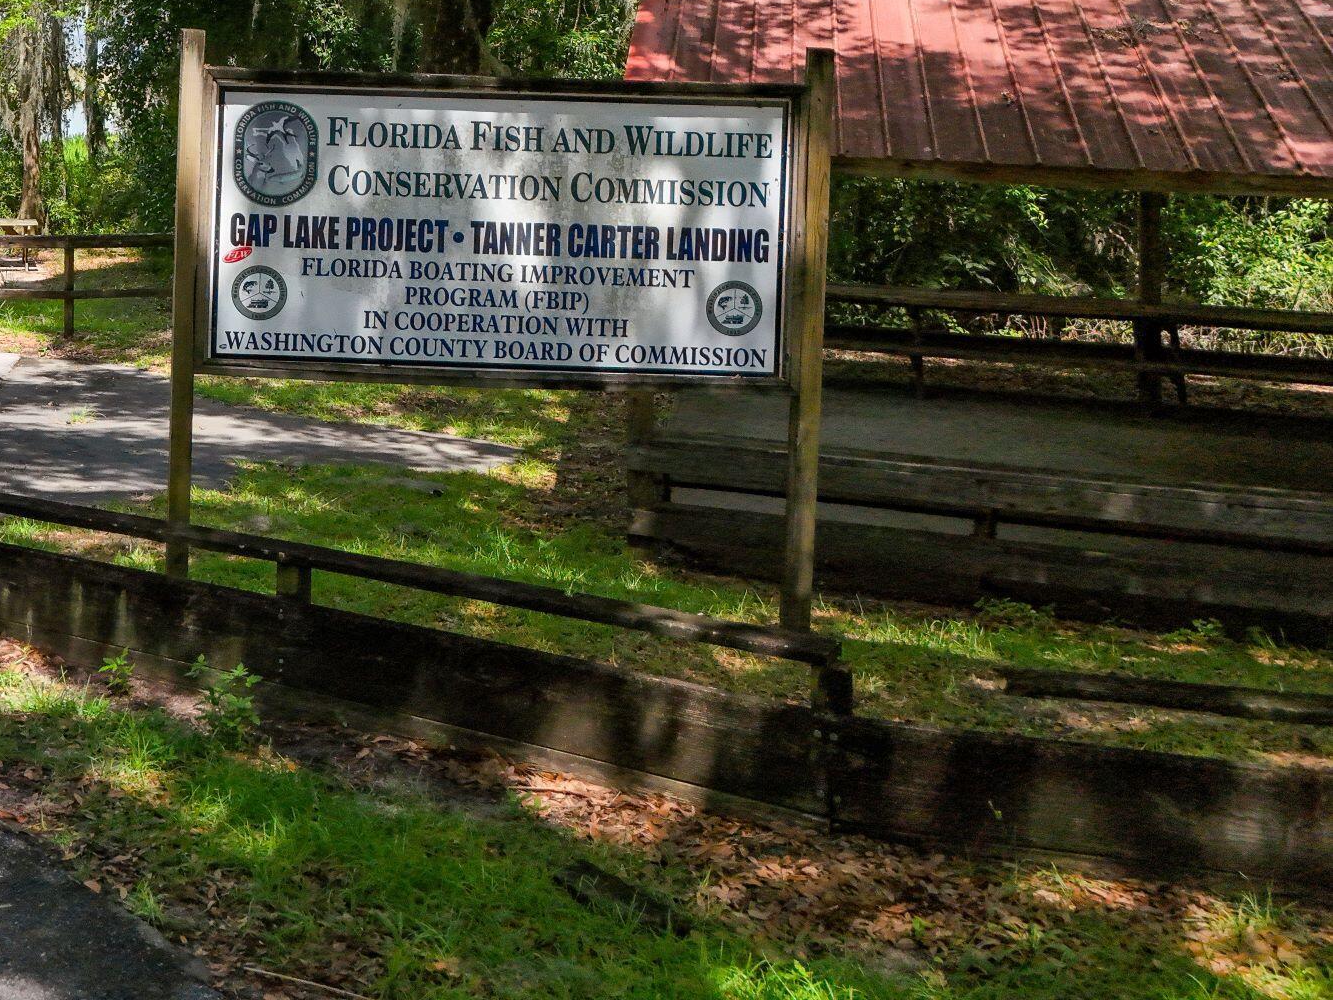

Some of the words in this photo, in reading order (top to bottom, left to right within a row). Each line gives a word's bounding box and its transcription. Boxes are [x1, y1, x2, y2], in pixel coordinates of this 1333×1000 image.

[236, 110, 256, 142] FLORIDA
[257, 104, 276, 113] FISH
[278, 104, 297, 113] AND
[299, 111, 316, 146] WILDLIFE
[326, 116, 462, 150] FLORIDA
[470, 120, 545, 152] FISH
[551, 127, 615, 154] AND
[623, 125, 772, 159] WILDLIFE
[235, 158, 277, 205] CONSERVATION
[282, 161, 315, 204] COMMISSION
[327, 164, 562, 201] CONSERVATION
[570, 172, 770, 208] COMMISSION
[230, 213, 278, 248] GAP
[283, 214, 340, 250] LAKE
[346, 217, 449, 253] PROJECT
[471, 221, 561, 257] TANNER
[568, 223, 660, 260] CARTER
[666, 226, 770, 263] LANDING
[301, 257, 403, 279] FLORIDA
[409, 260, 514, 283] BOATING
[520, 264, 695, 288] IMPROVEMENT
[404, 286, 518, 309] PROGRAM
[524, 290, 589, 314] (FBIP)
[364, 310, 389, 329] IN
[394, 311, 558, 335] COOPERATION
[565, 317, 629, 338] WITH
[224, 331, 384, 354] WASHINGTON
[389, 336, 488, 358] COUNTY
[494, 340, 573, 361] BOARD
[579, 343, 610, 362] OF
[615, 344, 768, 368] COMMISSION
